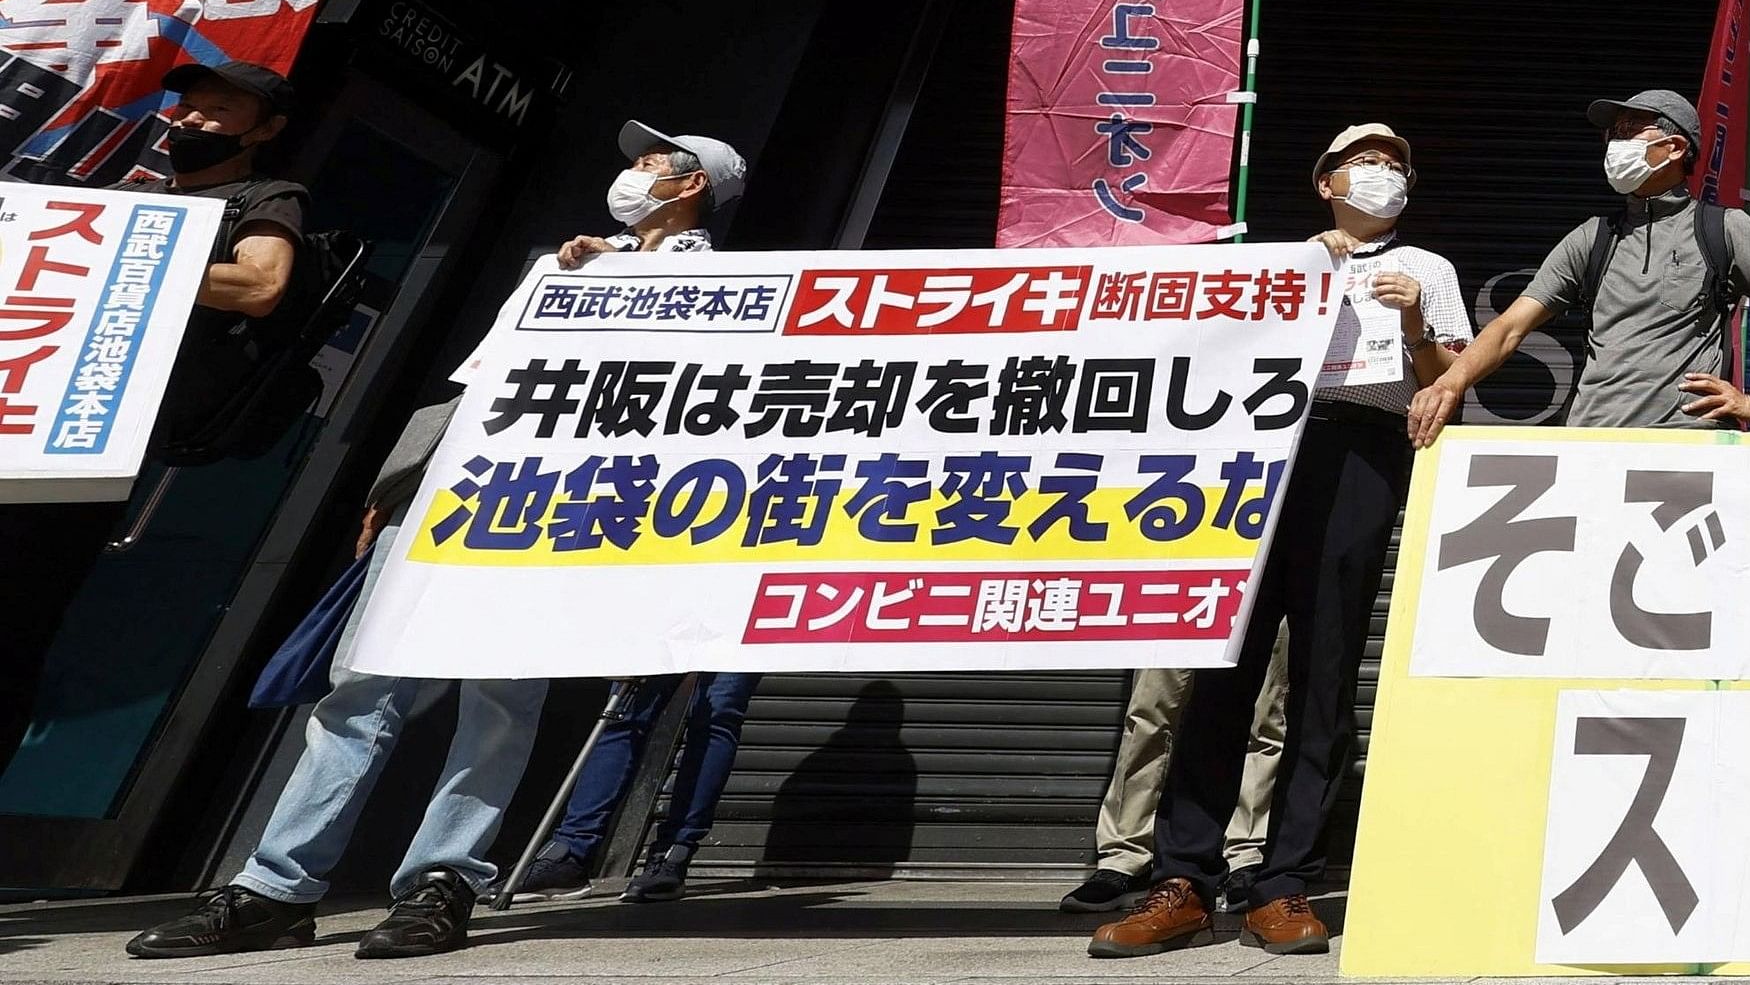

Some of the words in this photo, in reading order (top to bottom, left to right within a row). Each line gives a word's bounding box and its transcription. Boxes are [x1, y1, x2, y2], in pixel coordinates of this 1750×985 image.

[380, 19, 453, 73] SAISON
[391, 1, 464, 56] CREDIT
[452, 54, 535, 127] ATM
[52, 209, 178, 449] 西武百貨店池袋本店
[534, 283, 777, 322] 西武池袋本店
[797, 270, 1080, 329] ストライキ
[1089, 268, 1331, 322] 断固支持！
[482, 357, 1309, 440] 井阪は売却を撤回しろ
[430, 451, 1287, 552] 池袋の街を変えるな
[754, 578, 1250, 634] コンビニ関連ユニオ
